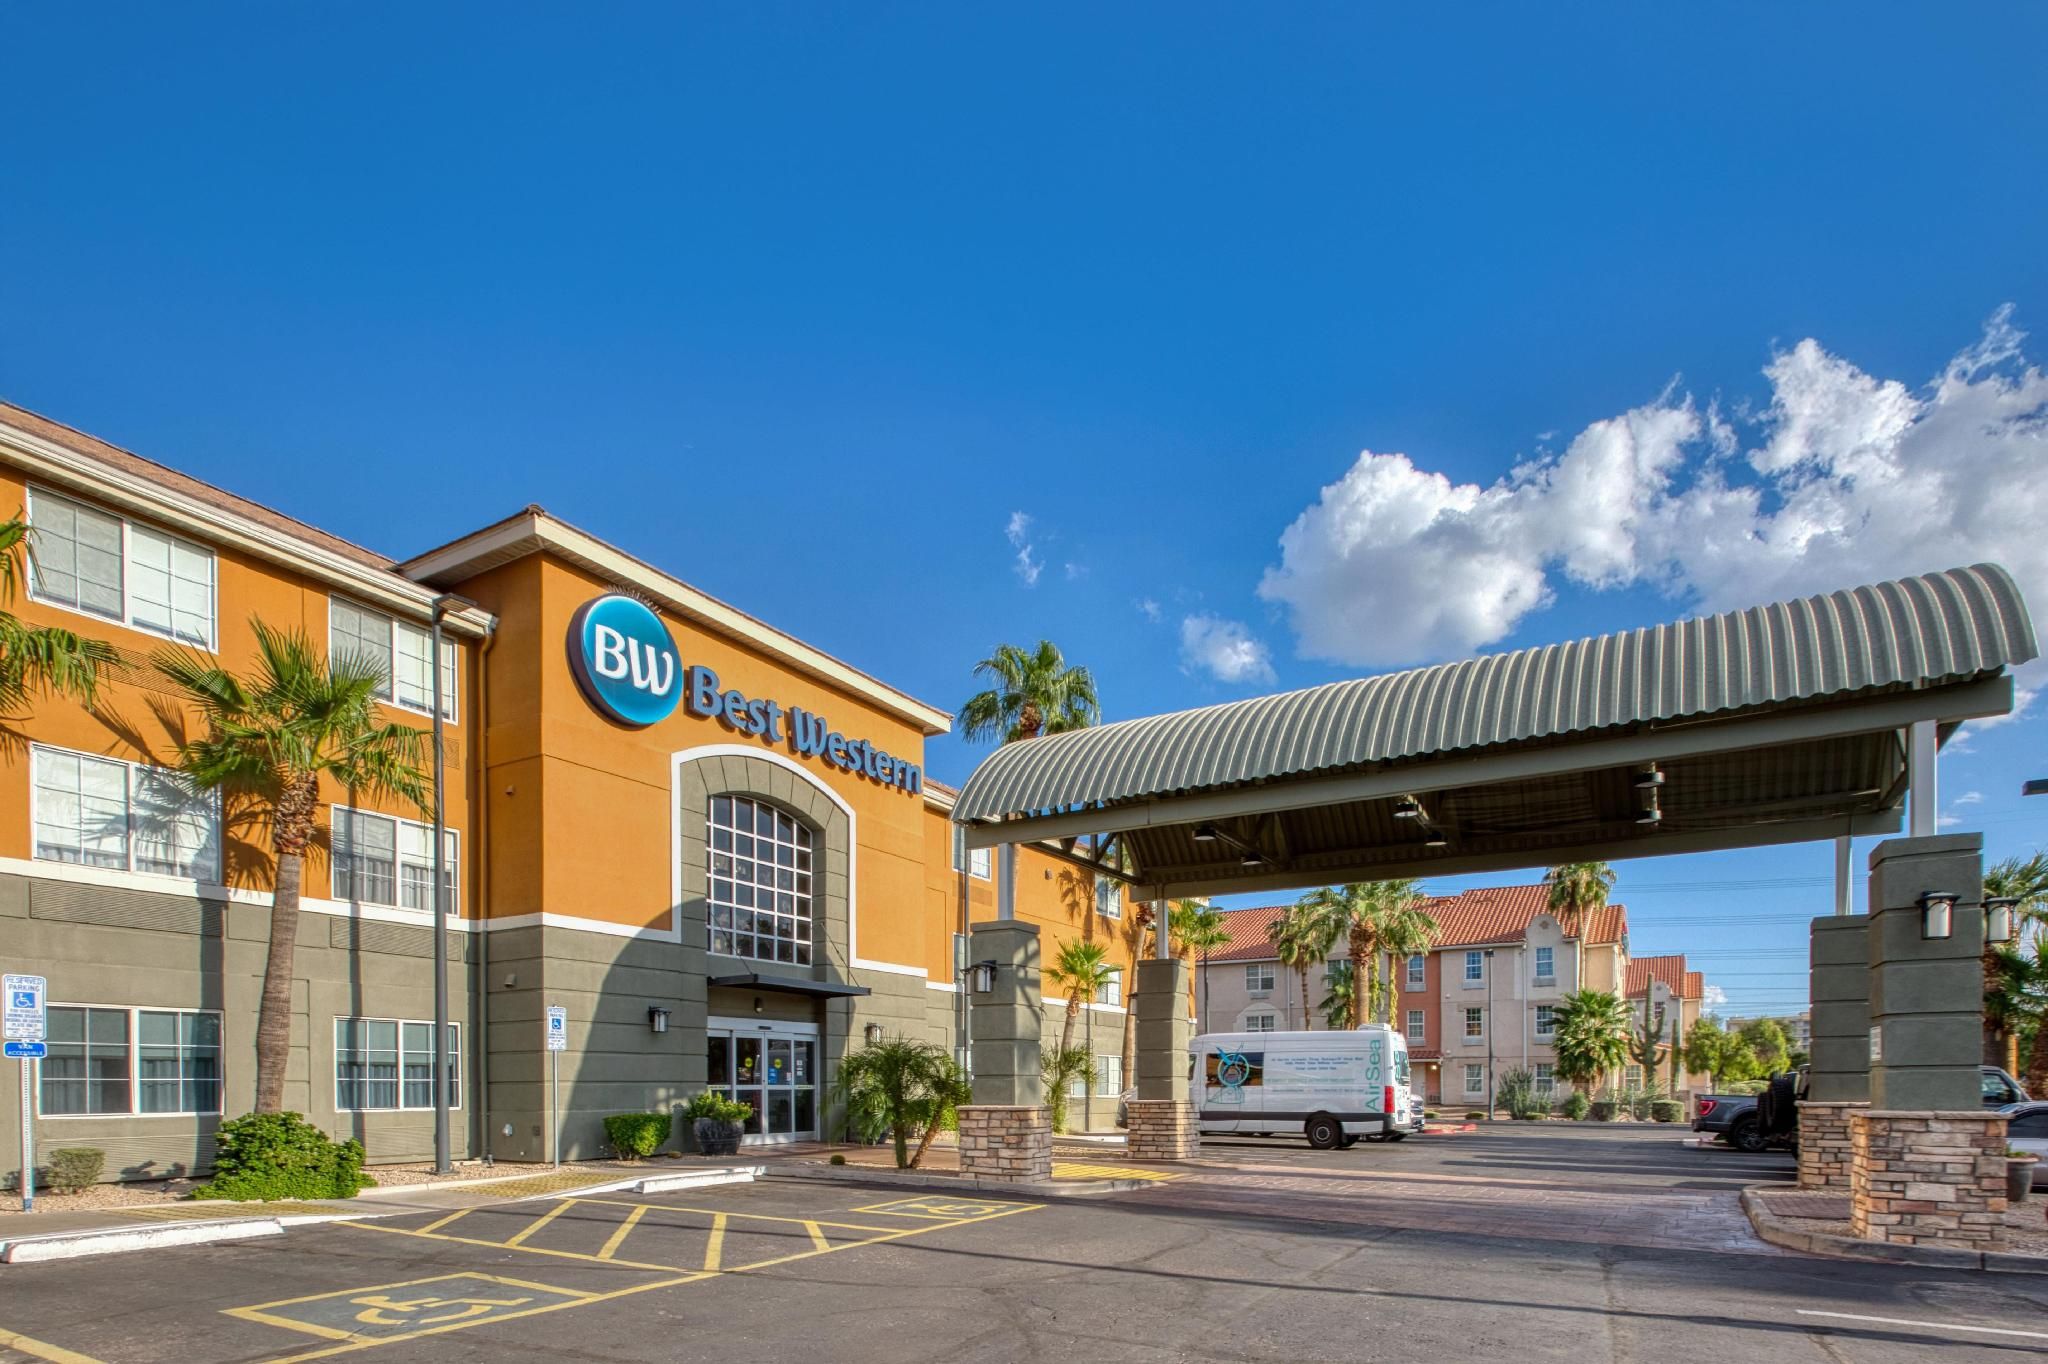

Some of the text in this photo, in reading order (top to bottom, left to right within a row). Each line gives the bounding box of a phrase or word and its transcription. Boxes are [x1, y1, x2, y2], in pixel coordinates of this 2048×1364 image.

[594, 623, 674, 697] BW
[688, 665, 923, 795] Best Western
[8, 984, 40, 992] PARKING
[1365, 1039, 1381, 1112] AirSea
